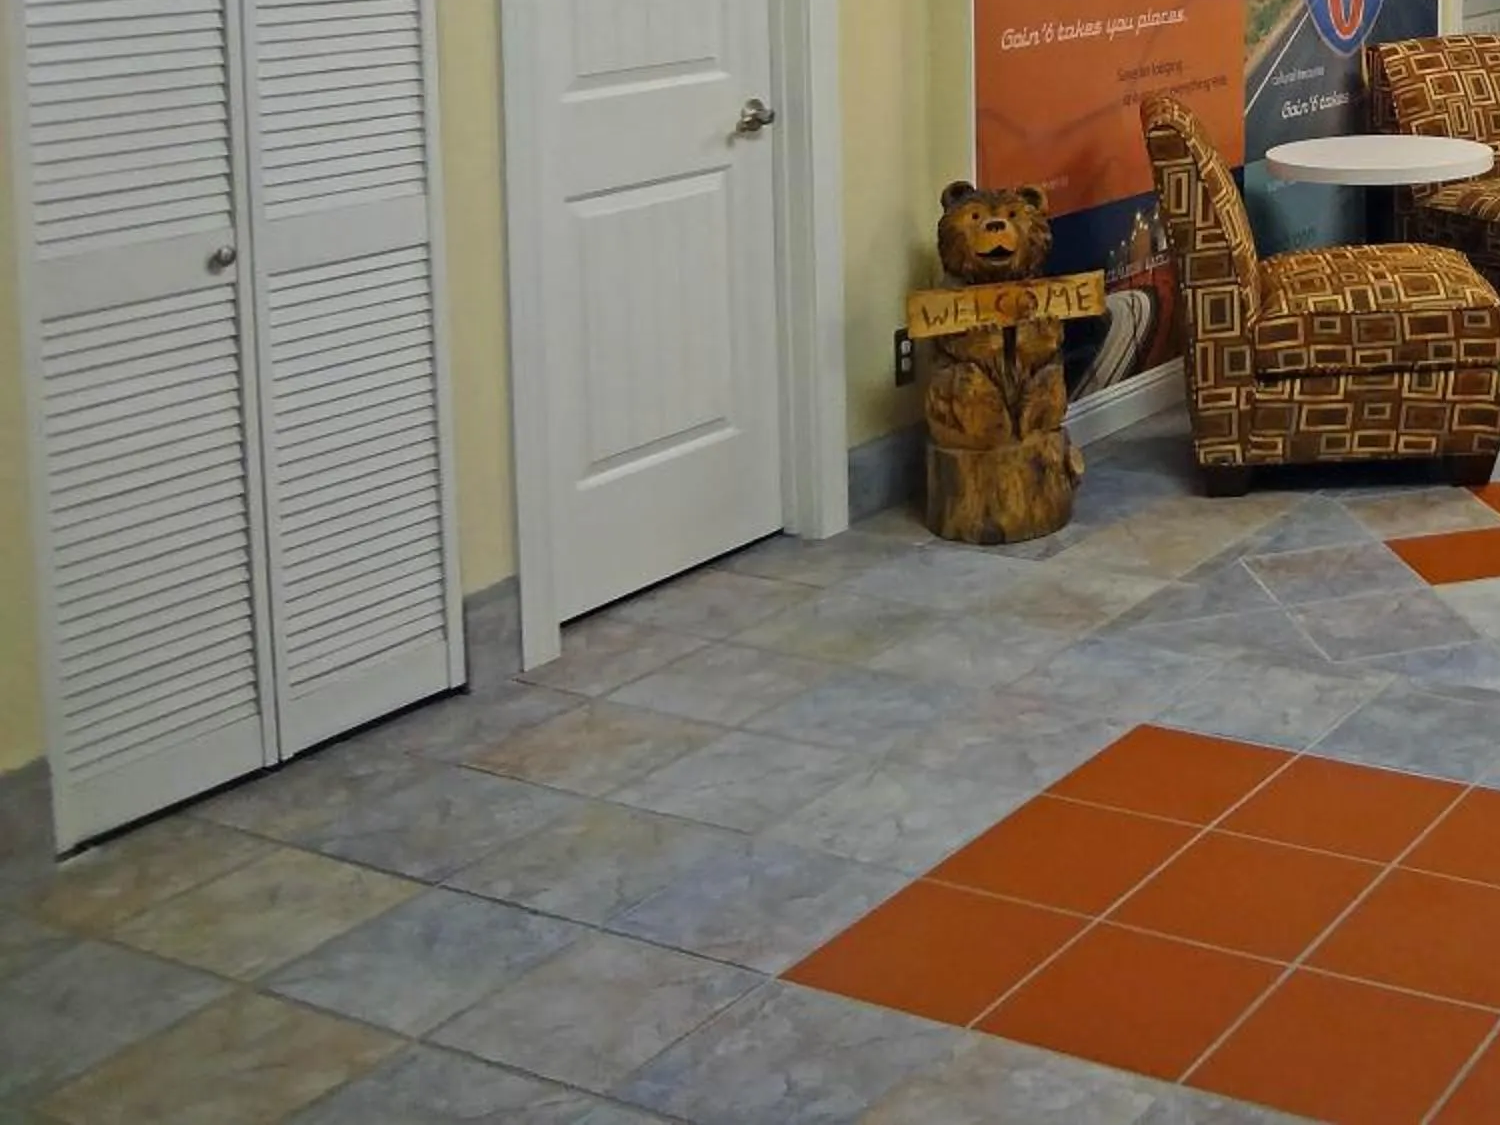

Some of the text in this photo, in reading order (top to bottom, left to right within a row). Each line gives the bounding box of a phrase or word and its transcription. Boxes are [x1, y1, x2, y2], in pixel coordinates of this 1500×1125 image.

[1057, 20, 1102, 41] takes
[1106, 18, 1133, 41] you
[921, 282, 1090, 329] WELCOME
